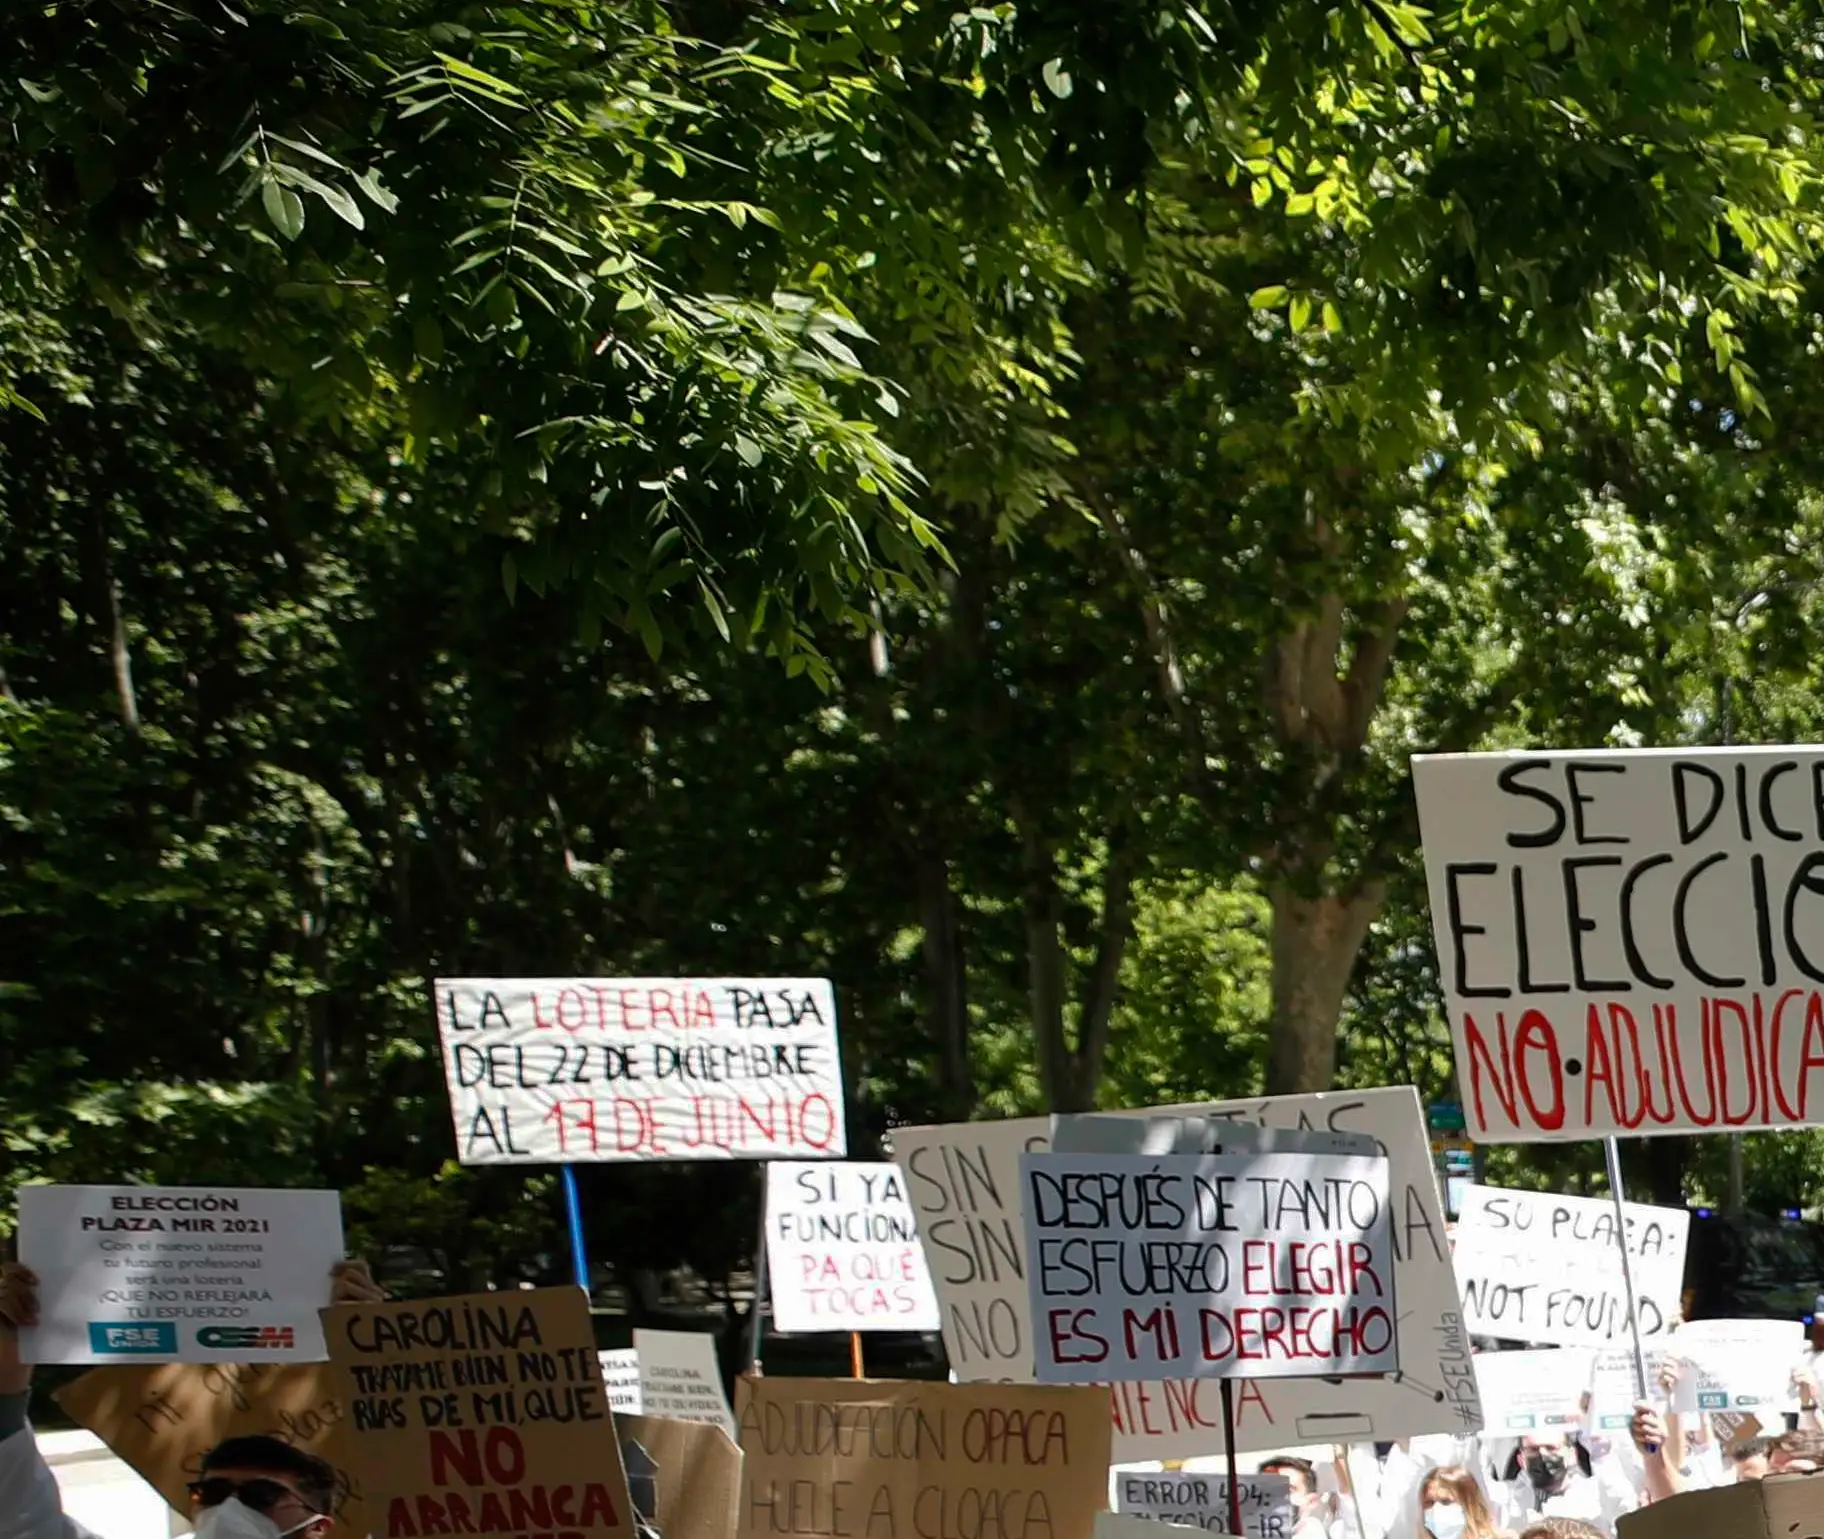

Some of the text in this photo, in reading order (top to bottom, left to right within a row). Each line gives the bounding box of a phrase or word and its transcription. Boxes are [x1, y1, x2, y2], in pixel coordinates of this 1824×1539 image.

[1500, 761, 1629, 848] SE
[448, 991, 511, 1030] LA
[729, 987, 824, 1026] PASA
[455, 1042, 817, 1088] DEL 22 DE DICIEMBRE
[467, 1105, 530, 1154] AL
[613, 1098, 668, 1153] DE
[681, 1092, 836, 1149] JUNIO
[110, 1195, 239, 1212] ELECCIÓN
[859, 1174, 903, 1203] YA
[909, 1144, 1004, 1213] SIN
[1030, 1165, 1379, 1231] DESPUÉS DE TANTO
[81, 1217, 270, 1234] PLAZA MIR 2021
[1483, 1198, 1533, 1232] SU
[800, 1253, 841, 1282] PA
[928, 1216, 1023, 1285] SIN
[1040, 1237, 1384, 1297] ESFUERZO ELEGIR
[801, 1286, 915, 1315] TOCAS
[1461, 1278, 1539, 1323] NOT
[105, 1328, 161, 1341] FSE
[346, 1301, 542, 1352] CAROLINA
[948, 1298, 1021, 1362] NO
[1050, 1301, 1393, 1364] ES MI DERECHO
[350, 1359, 447, 1394] TRATAME
[450, 1353, 510, 1387] BIEN
[515, 1351, 557, 1382] NO
[558, 1348, 598, 1382] TE
[419, 1392, 464, 1427] DE
[524, 1385, 604, 1424] QUE
[741, 1397, 1069, 1465] ADJUDICACIÓN OPACA
[429, 1426, 525, 1487] NO
[387, 1482, 619, 1538] ARRANCA
[748, 1481, 853, 1538] HUELE
[865, 1485, 896, 1538] A
